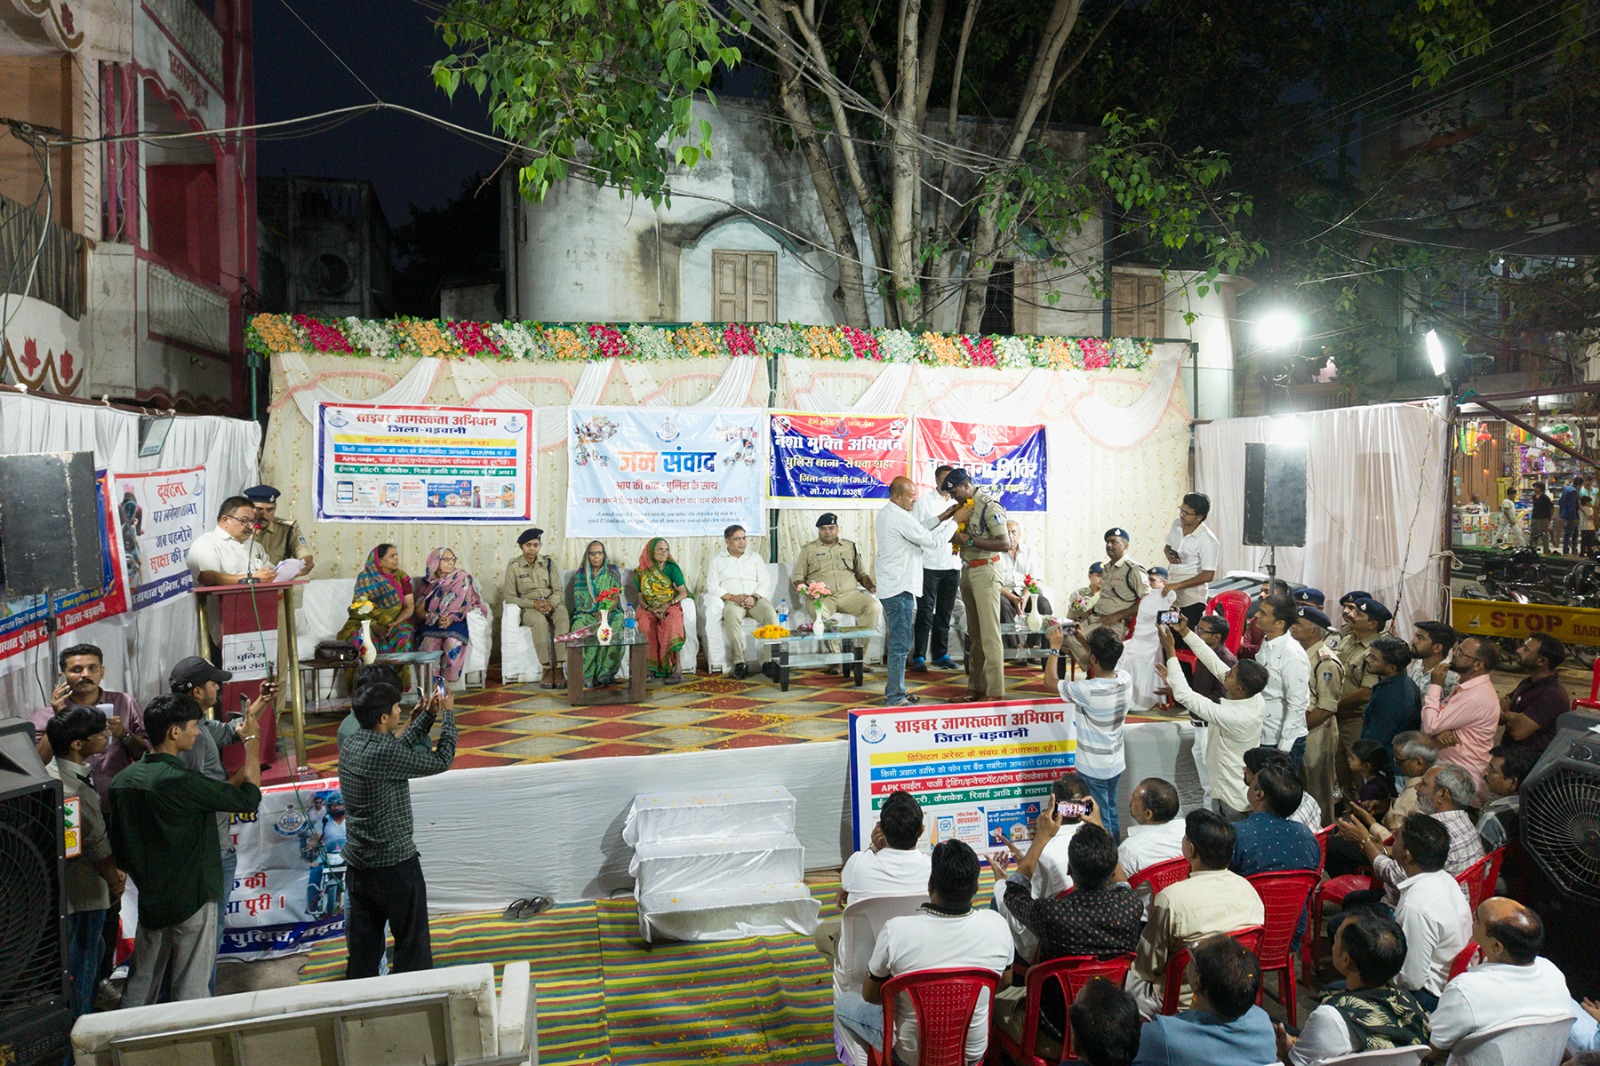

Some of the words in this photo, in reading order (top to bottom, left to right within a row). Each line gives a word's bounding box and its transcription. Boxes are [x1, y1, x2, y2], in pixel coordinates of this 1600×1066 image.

[356, 414, 390, 424] साइबर
[394, 414, 448, 424] जागरूकता
[452, 414, 497, 426] अभियान
[775, 435, 803, 448] नशा
[807, 435, 843, 454] मुक्ति
[848, 435, 903, 451] अभियान
[618, 451, 658, 472] जन
[661, 446, 717, 472] संवाद
[785, 455, 813, 470] पुलिस
[874, 460, 895, 468] शहर
[157, 478, 187, 505] दुर्घटना
[616, 481, 631, 490] आप
[632, 479, 644, 490] की
[666, 479, 689, 493] पुलिस
[701, 481, 718, 490] साथ
[153, 510, 162, 523] पर
[150, 553, 170, 574] सुरक्षा
[171, 547, 182, 564] की
[1491, 611, 1563, 632] STOP
[895, 718, 938, 734] साइबर
[941, 714, 1007, 730] जागरूकता
[1011, 710, 1064, 725] अभियान
[907, 753, 938, 762] डिजिटल
[942, 751, 964, 760] अरेस्ट
[967, 749, 975, 757] के
[978, 748, 998, 757] संबंध
[880, 768, 897, 778] किसी
[919, 765, 936, 775] व्यक्ति
[938, 764, 946, 773] को
[948, 764, 960, 772] फोन
[1009, 758, 1035, 768] जानकारी
[1036, 758, 1065, 766] OTP/PIN
[881, 783, 899, 792] APK
[900, 781, 924, 791] फाईल,
[926, 778, 944, 788] फर्जी
[969, 789, 990, 800] रिवार्ड
[993, 788, 1011, 798] आदि
[1024, 786, 1047, 795] लालच
[243, 872, 267, 889] की
[245, 894, 272, 916] पूरी
[229, 930, 294, 947] पुलिस,
